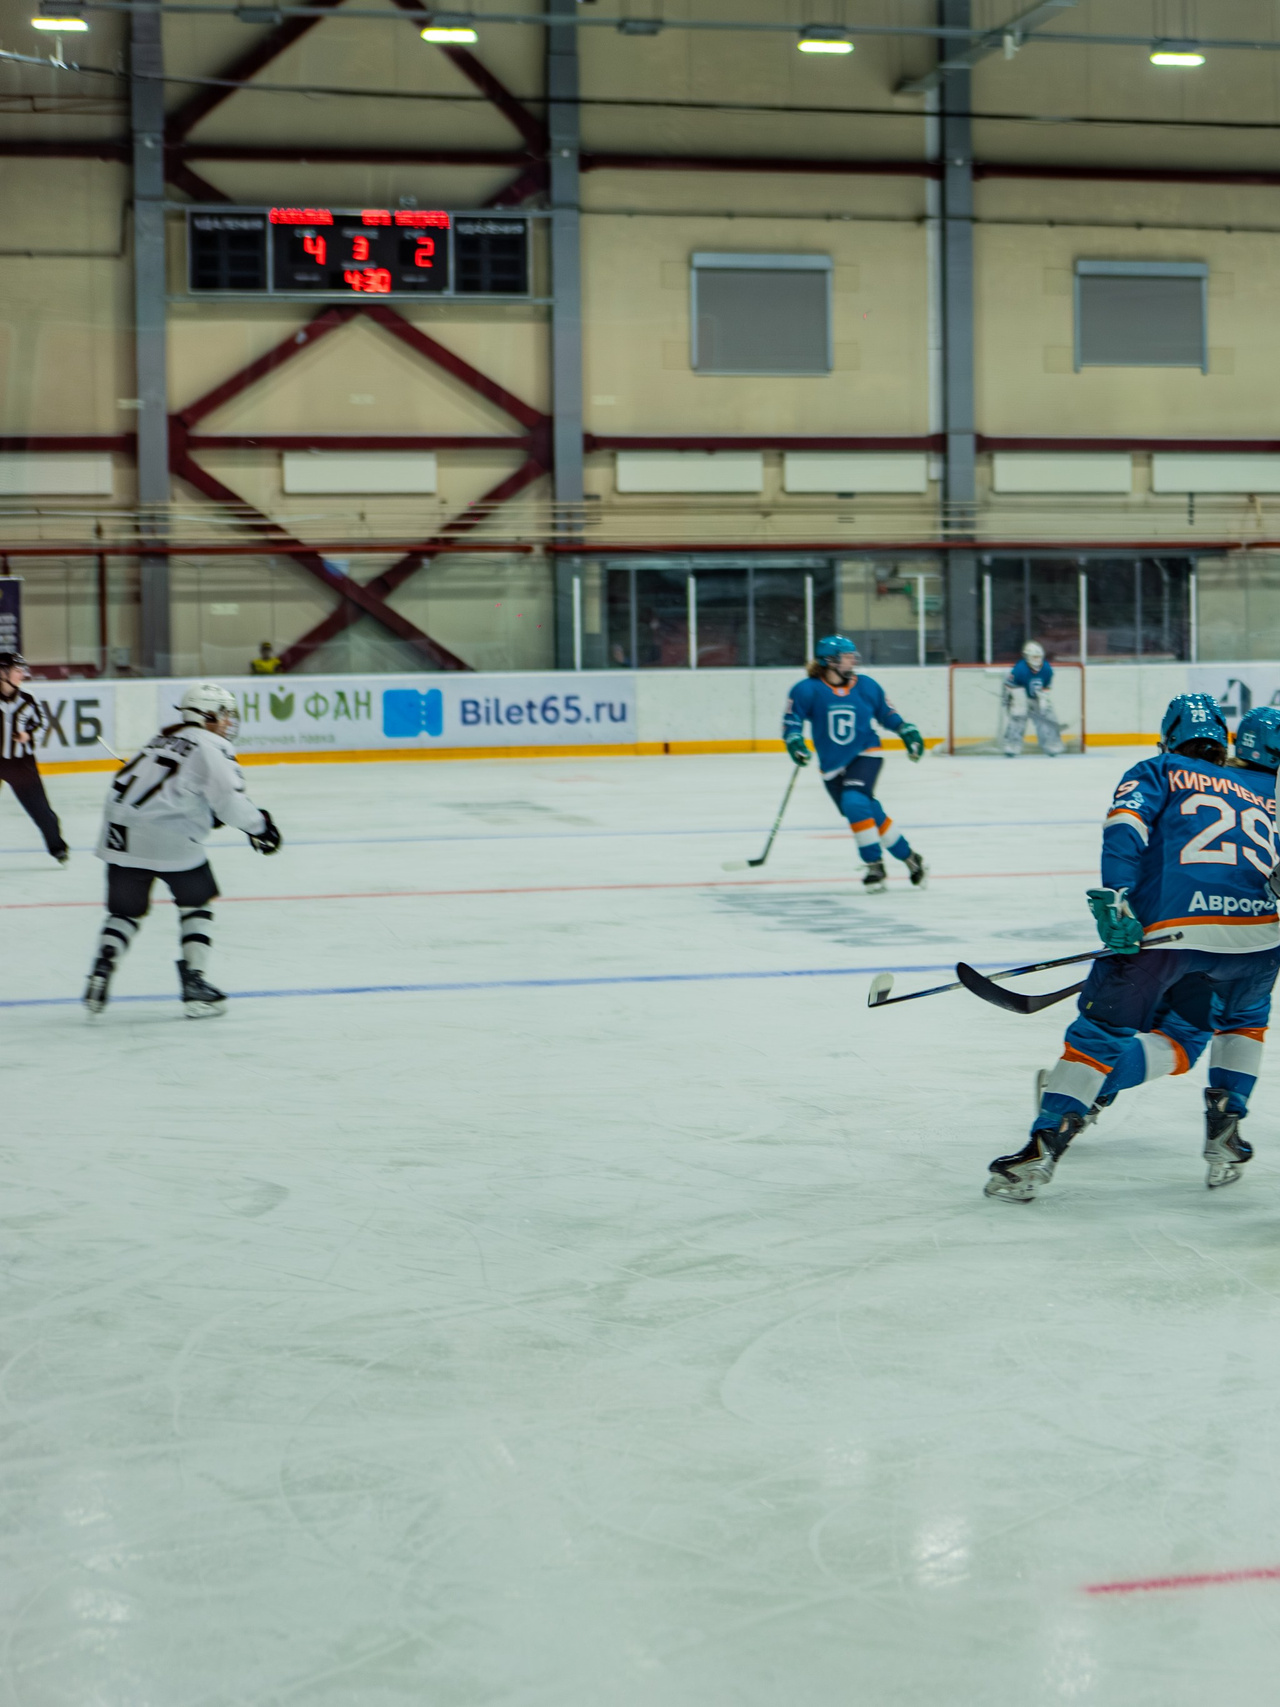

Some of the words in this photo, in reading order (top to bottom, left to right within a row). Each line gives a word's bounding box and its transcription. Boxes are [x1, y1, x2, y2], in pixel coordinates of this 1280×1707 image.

[303, 235, 326, 265] 4
[352, 235, 369, 261] 3
[415, 236, 435, 267] 2
[304, 691, 372, 721] ФАН
[460, 694, 627, 726] Bilet65.ru
[1191, 709, 1207, 722] 29
[1180, 793, 1280, 880] 29
